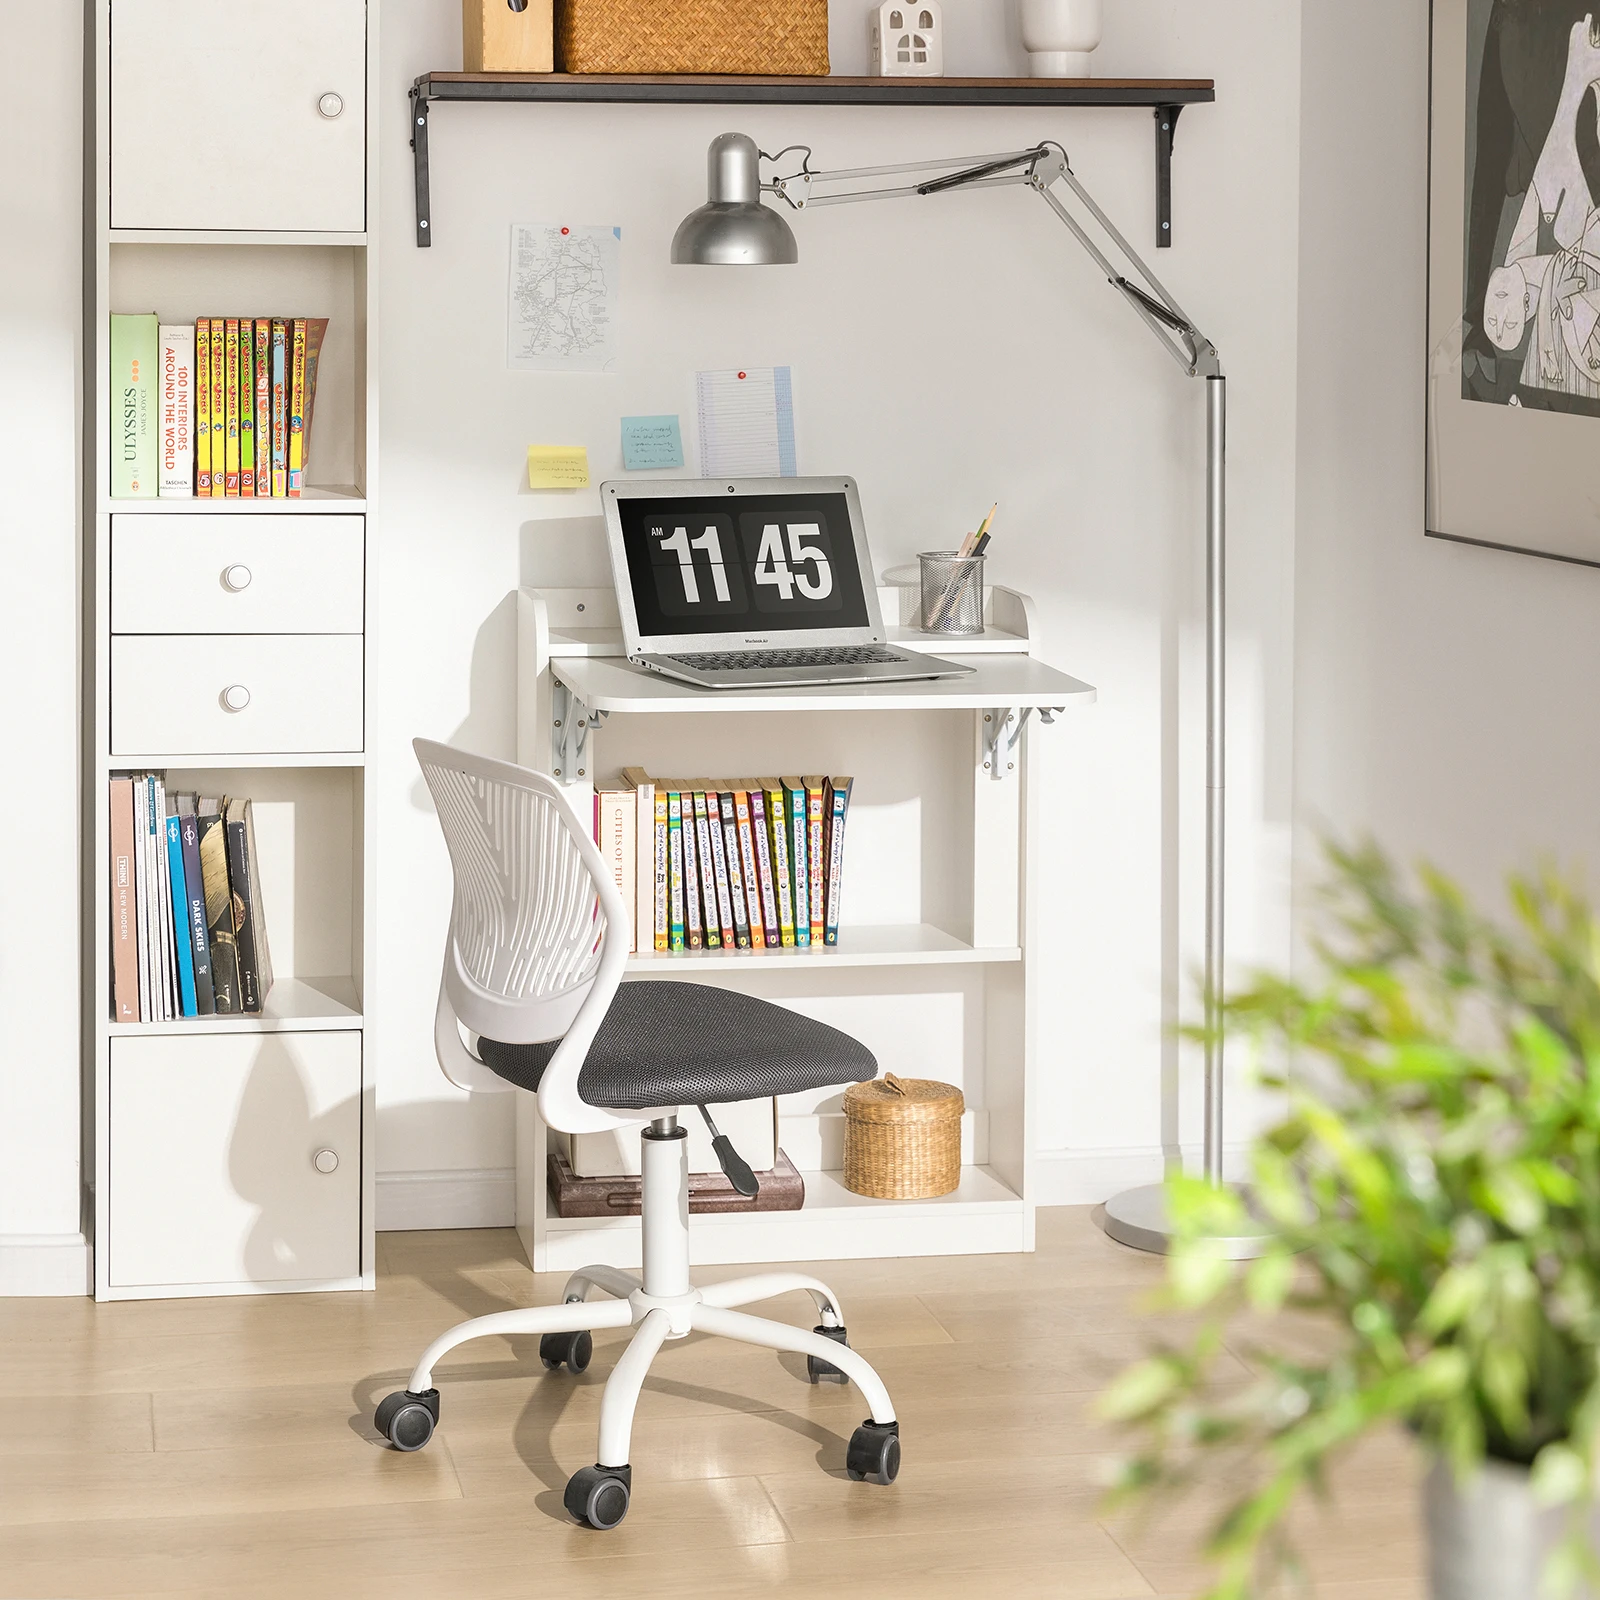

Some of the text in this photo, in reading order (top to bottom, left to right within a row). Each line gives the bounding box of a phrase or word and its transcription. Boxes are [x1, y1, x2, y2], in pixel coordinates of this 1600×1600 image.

[124, 388, 137, 462] ULYSSES
[165, 347, 175, 470] AROUND THE WORLD
[178, 366, 188, 451] 100 INTERIORS
[651, 527, 664, 536] AM
[660, 523, 833, 603] 11 45
[615, 808, 623, 845] CITIES
[712, 821, 720, 839] Diary
[119, 859, 127, 884] THINK
[615, 847, 622, 862] OF
[192, 900, 205, 952] DARK SKIES
